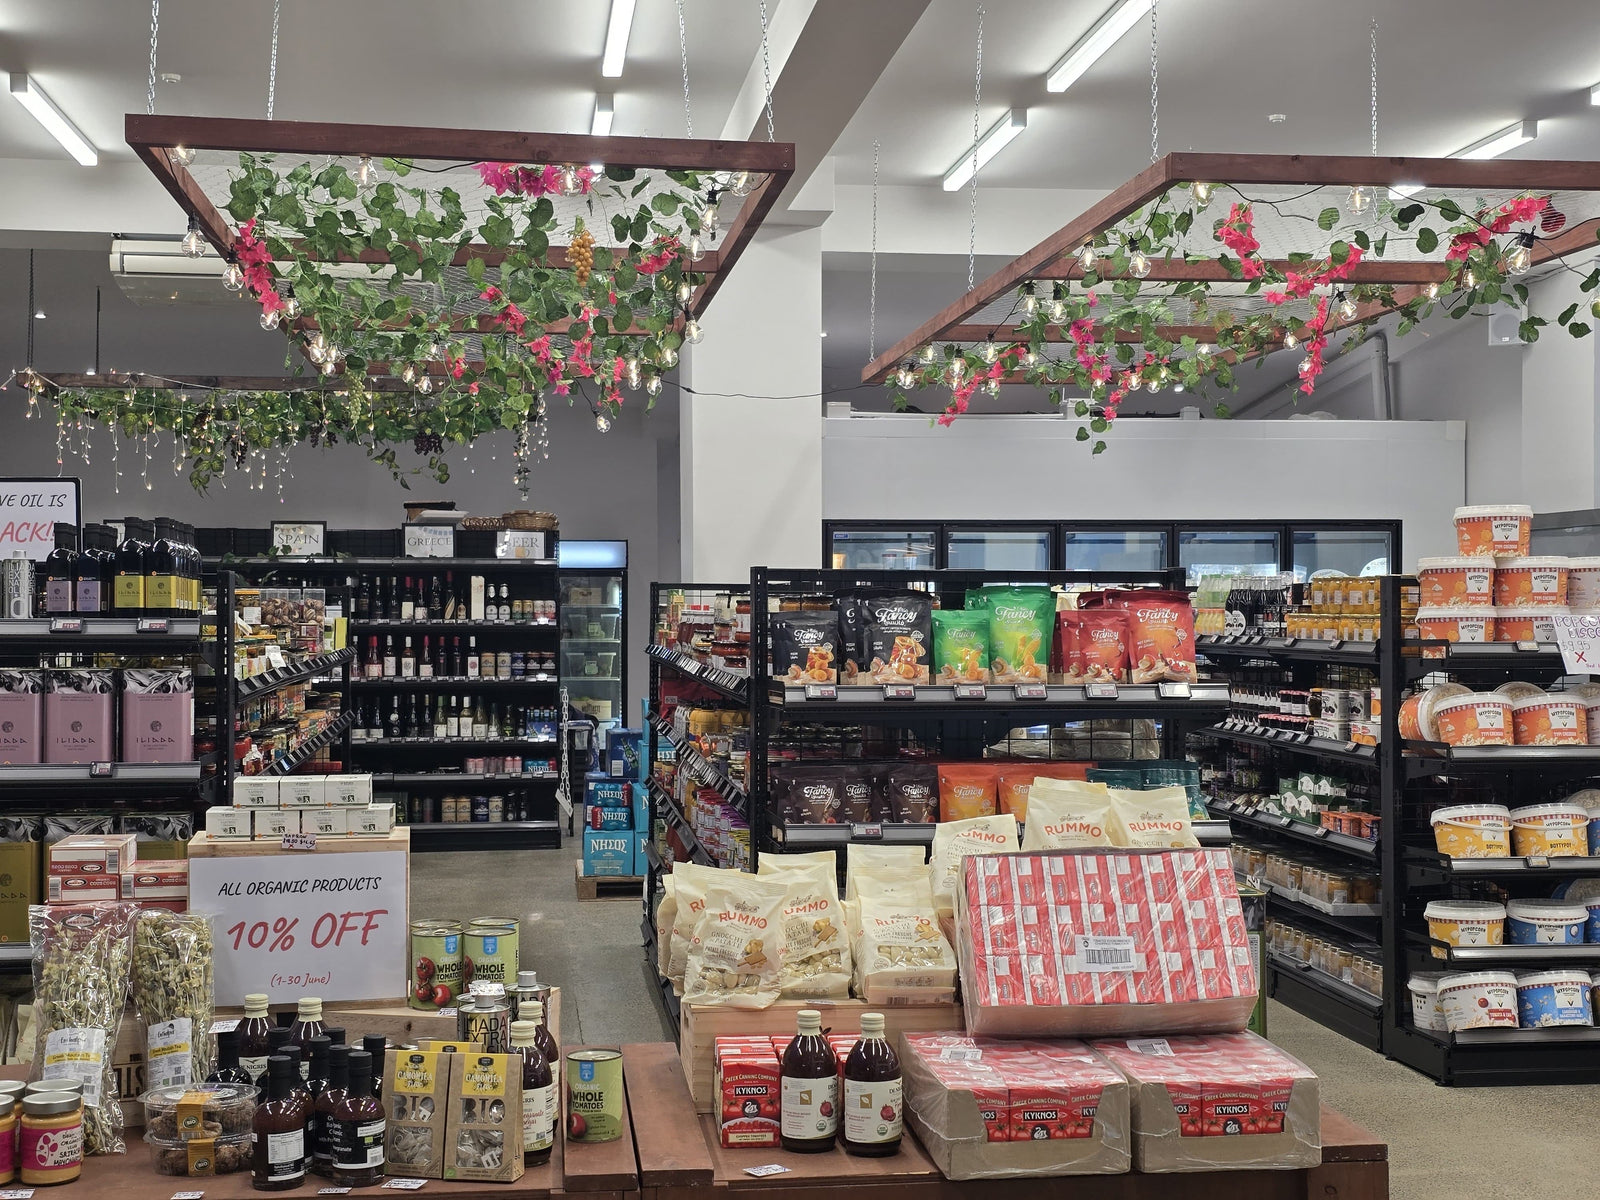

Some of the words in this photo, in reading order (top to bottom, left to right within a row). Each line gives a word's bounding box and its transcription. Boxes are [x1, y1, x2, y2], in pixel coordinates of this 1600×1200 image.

[20, 493, 44, 508] OIL
[48, 493, 67, 508] IS
[277, 533, 320, 546] SPAIN
[407, 536, 452, 548] GREECE
[995, 606, 1036, 622] Fancy
[1136, 608, 1179, 623] Fancy
[598, 790, 625, 801] ΝΗΣΟΣ
[953, 785, 984, 798] Fancy
[601, 811, 628, 823] ΝΗΣΟΣ
[1044, 822, 1102, 839] RUMMO
[1128, 821, 1183, 833] RUMMO
[591, 838, 628, 853] ΝΗΣΟΣ
[218, 882, 242, 896] ALL
[246, 880, 309, 895] ORGANIC
[312, 877, 382, 892] PRODUCTS
[784, 899, 829, 915] UMMO
[719, 911, 768, 929] RUMMO
[227, 917, 300, 952] 10%
[310, 909, 389, 949] OFF
[436, 962, 463, 973] WHOLE
[475, 963, 505, 974] WHOLE
[270, 974, 301, 987] (1-30
[301, 971, 331, 987] June)
[464, 1017, 507, 1032] ILIADA
[464, 1031, 507, 1044] EXTRA
[758, 1074, 777, 1082] COMPANY
[575, 1083, 601, 1091] ORGANIC
[735, 1086, 767, 1095] KYKNOS
[1277, 1088, 1292, 1096] CANN
[572, 1091, 604, 1102] WHOLE
[985, 1097, 1007, 1106] COMPANY
[1047, 1098, 1068, 1106] COMPANY
[1239, 1092, 1259, 1100] COMPANY
[391, 1094, 435, 1121] BIO
[460, 1097, 506, 1124] BIO
[572, 1102, 604, 1110] TOMATOES
[1216, 1105, 1248, 1114] KYKNOS
[1024, 1110, 1057, 1120] KYKNOS
